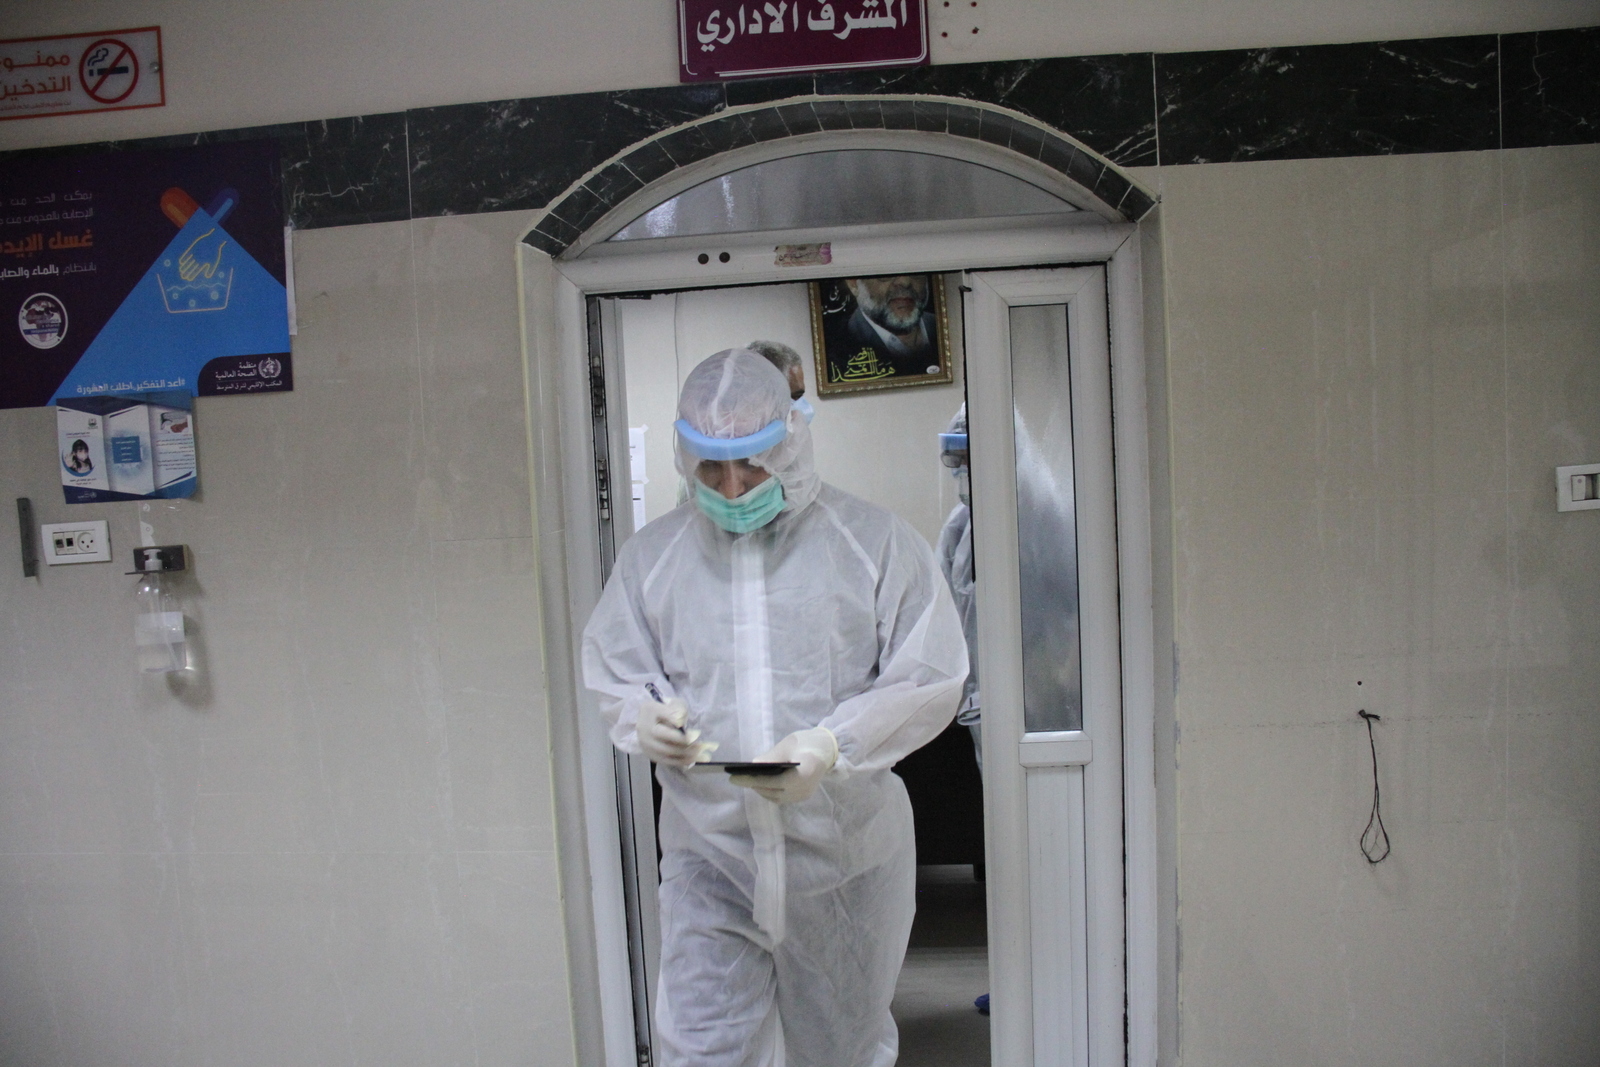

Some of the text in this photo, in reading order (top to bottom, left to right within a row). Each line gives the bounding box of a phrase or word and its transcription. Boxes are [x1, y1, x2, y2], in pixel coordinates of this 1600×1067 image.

[696, 0, 908, 52] المشرف الاداري
[0, 51, 70, 72] ممنو
[36, 193, 55, 203] الحد
[64, 190, 93, 201] يمكن
[10, 197, 27, 206] من
[48, 229, 93, 250] غسل
[0, 267, 29, 280] والصاب
[32, 264, 59, 276] بالماء
[239, 361, 257, 369] منظمة
[215, 369, 257, 380] الصحة العالمية
